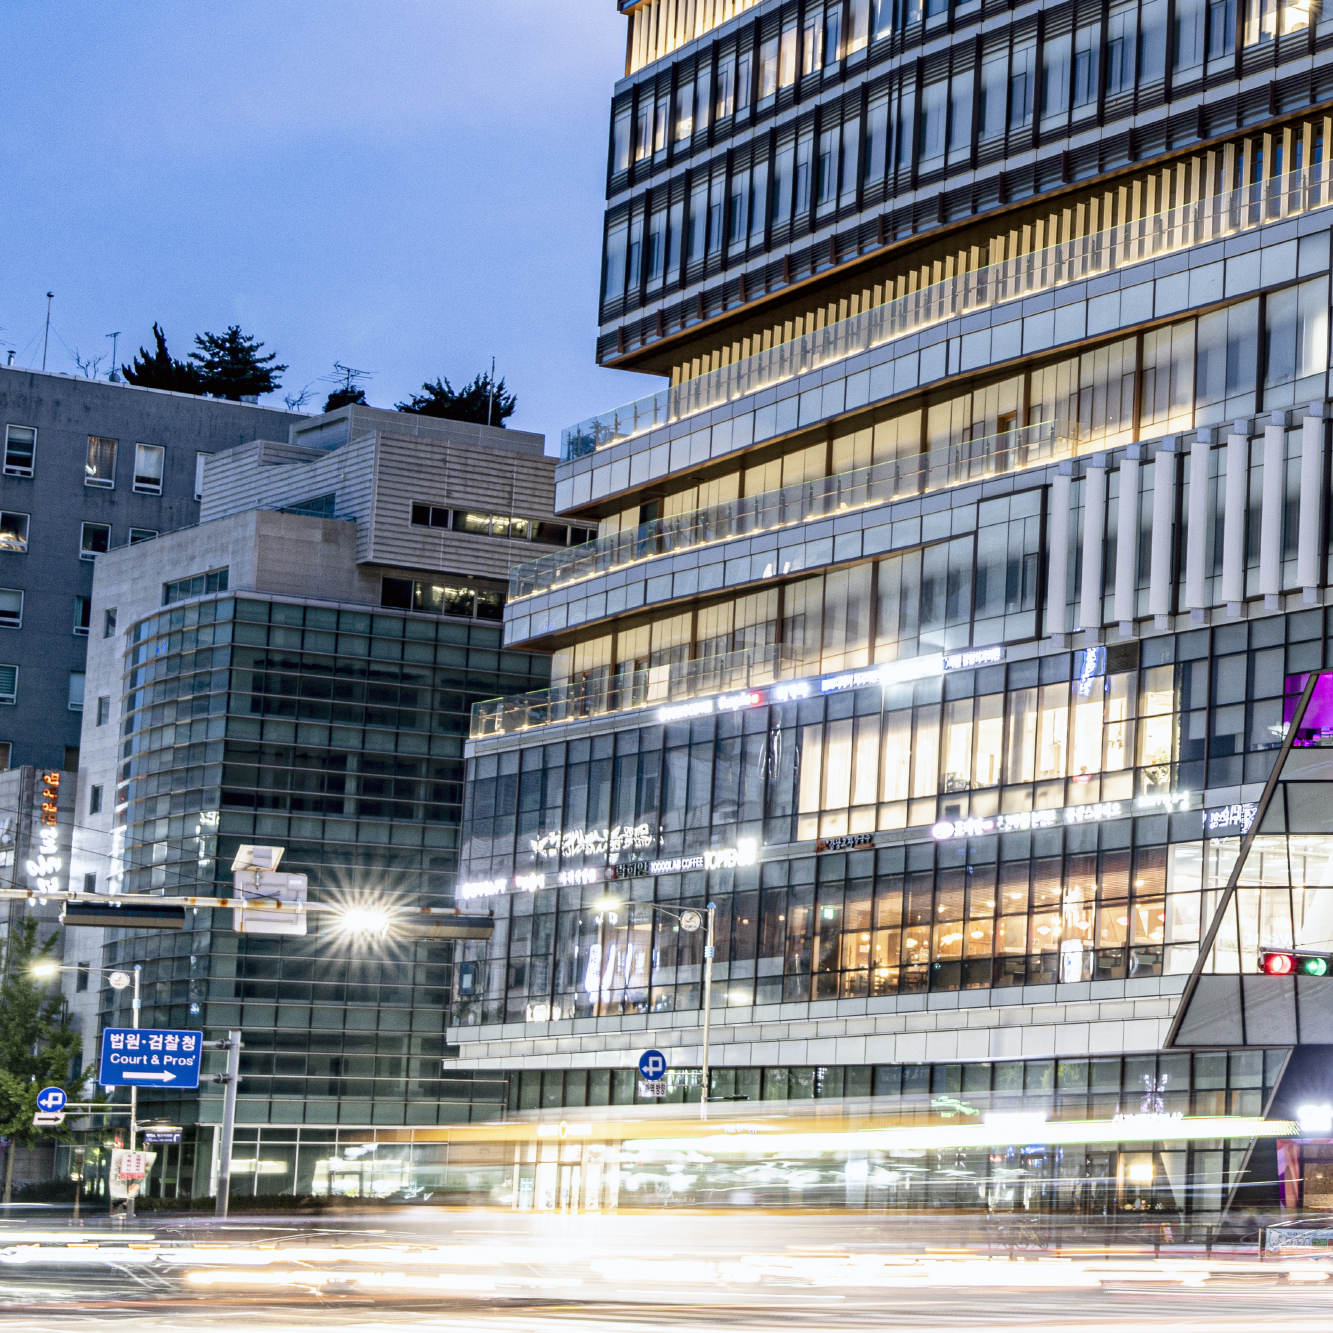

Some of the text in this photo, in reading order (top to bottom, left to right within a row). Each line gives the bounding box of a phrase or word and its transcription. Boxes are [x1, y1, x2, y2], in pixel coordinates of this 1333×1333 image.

[682, 856, 704, 869] COFFEE
[110, 1033, 196, 1052] 법원·검찰청
[110, 1053, 196, 1066] Court & Pros'
